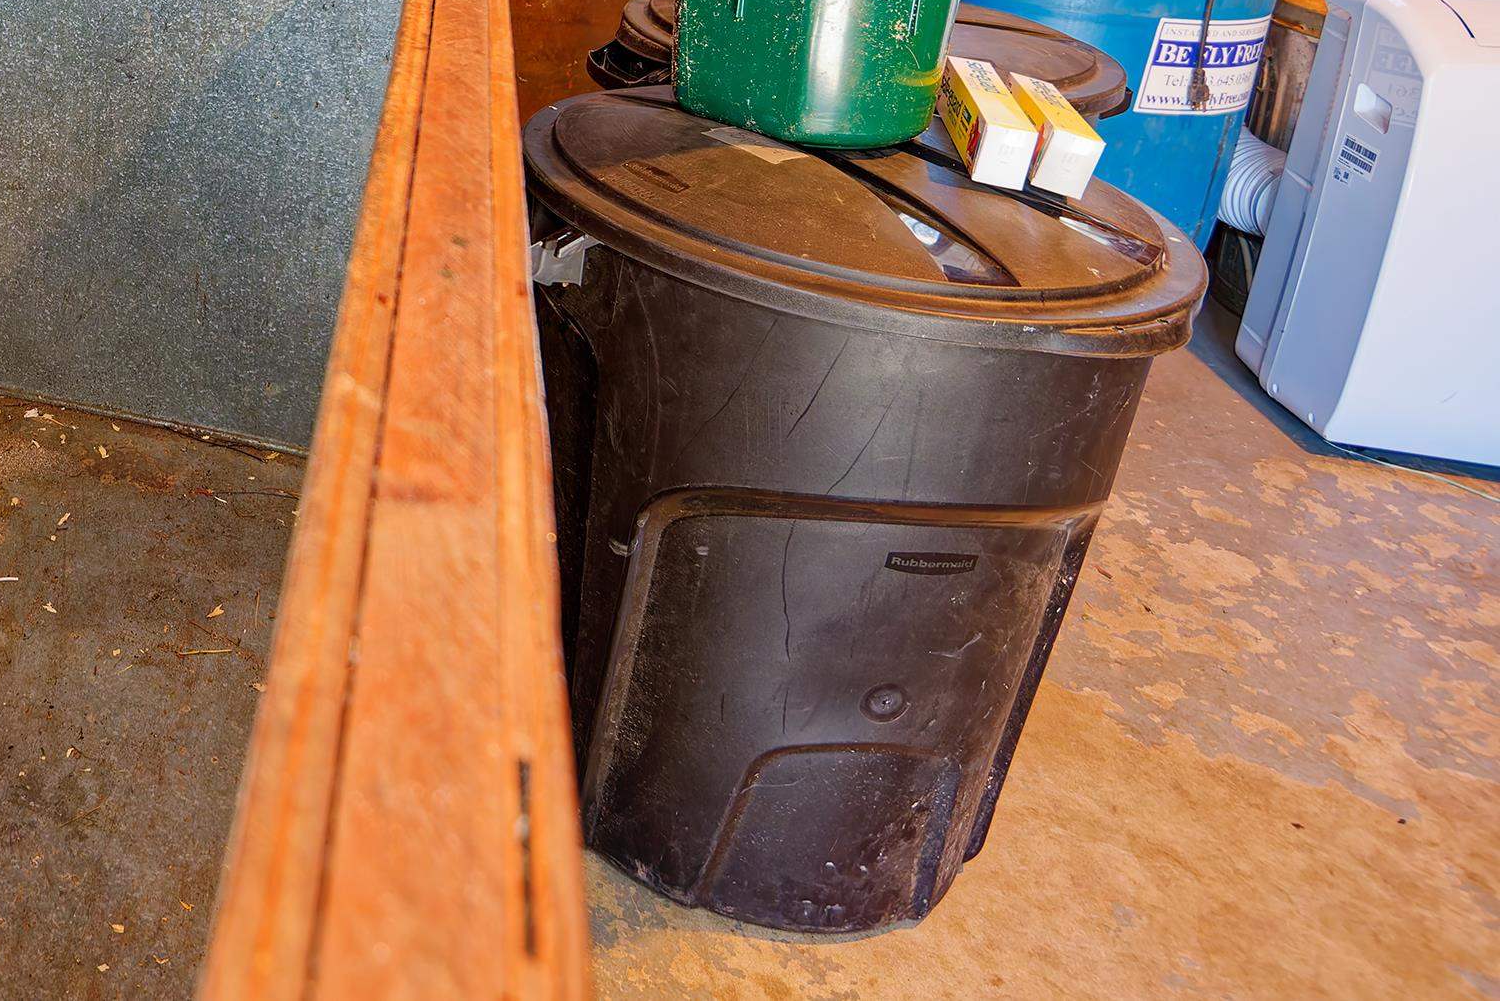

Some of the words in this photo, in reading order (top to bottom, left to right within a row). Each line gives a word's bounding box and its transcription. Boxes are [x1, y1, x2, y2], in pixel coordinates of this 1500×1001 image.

[1156, 43, 1192, 65] BE
[1164, 73, 1187, 87] Tel:
[1146, 89, 1250, 108] www.lyFree.com
[891, 556, 973, 569] Rubbermaid
